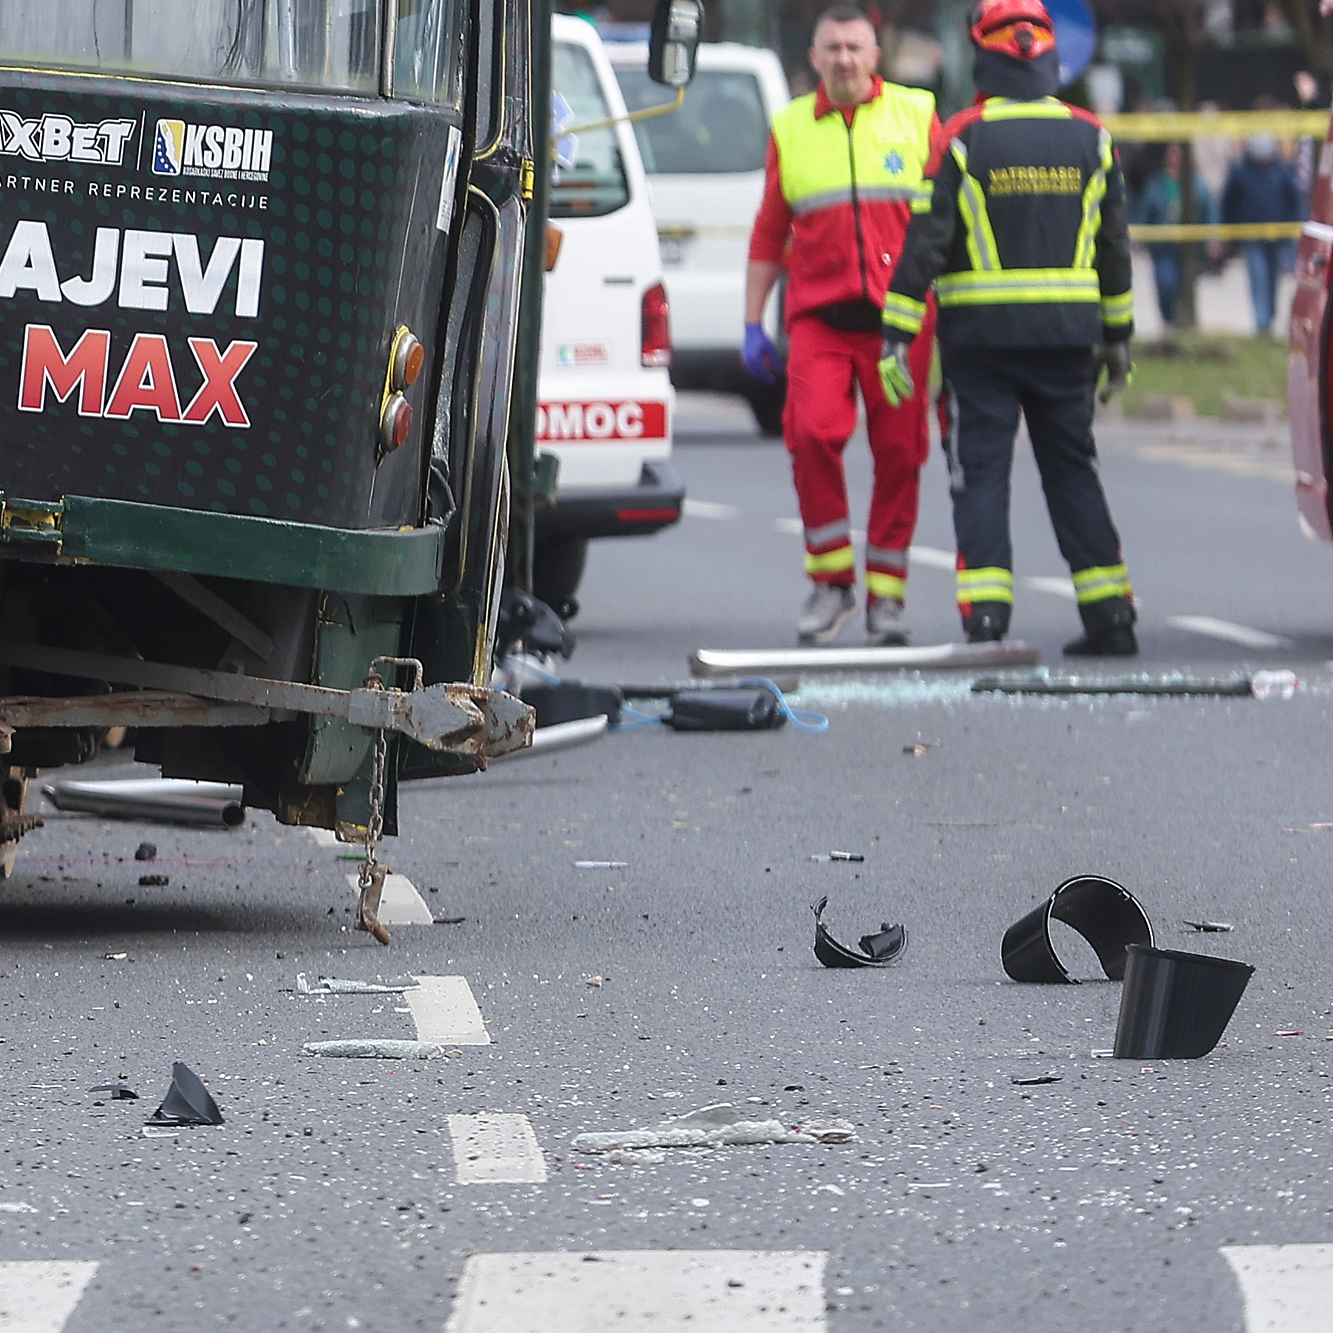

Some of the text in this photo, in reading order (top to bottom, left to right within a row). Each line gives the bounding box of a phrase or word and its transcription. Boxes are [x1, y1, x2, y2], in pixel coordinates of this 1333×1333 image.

[183, 123, 273, 172] KSBIH
[88, 181, 269, 210] REPREZENTACIJE
[18, 324, 258, 428] MAX
